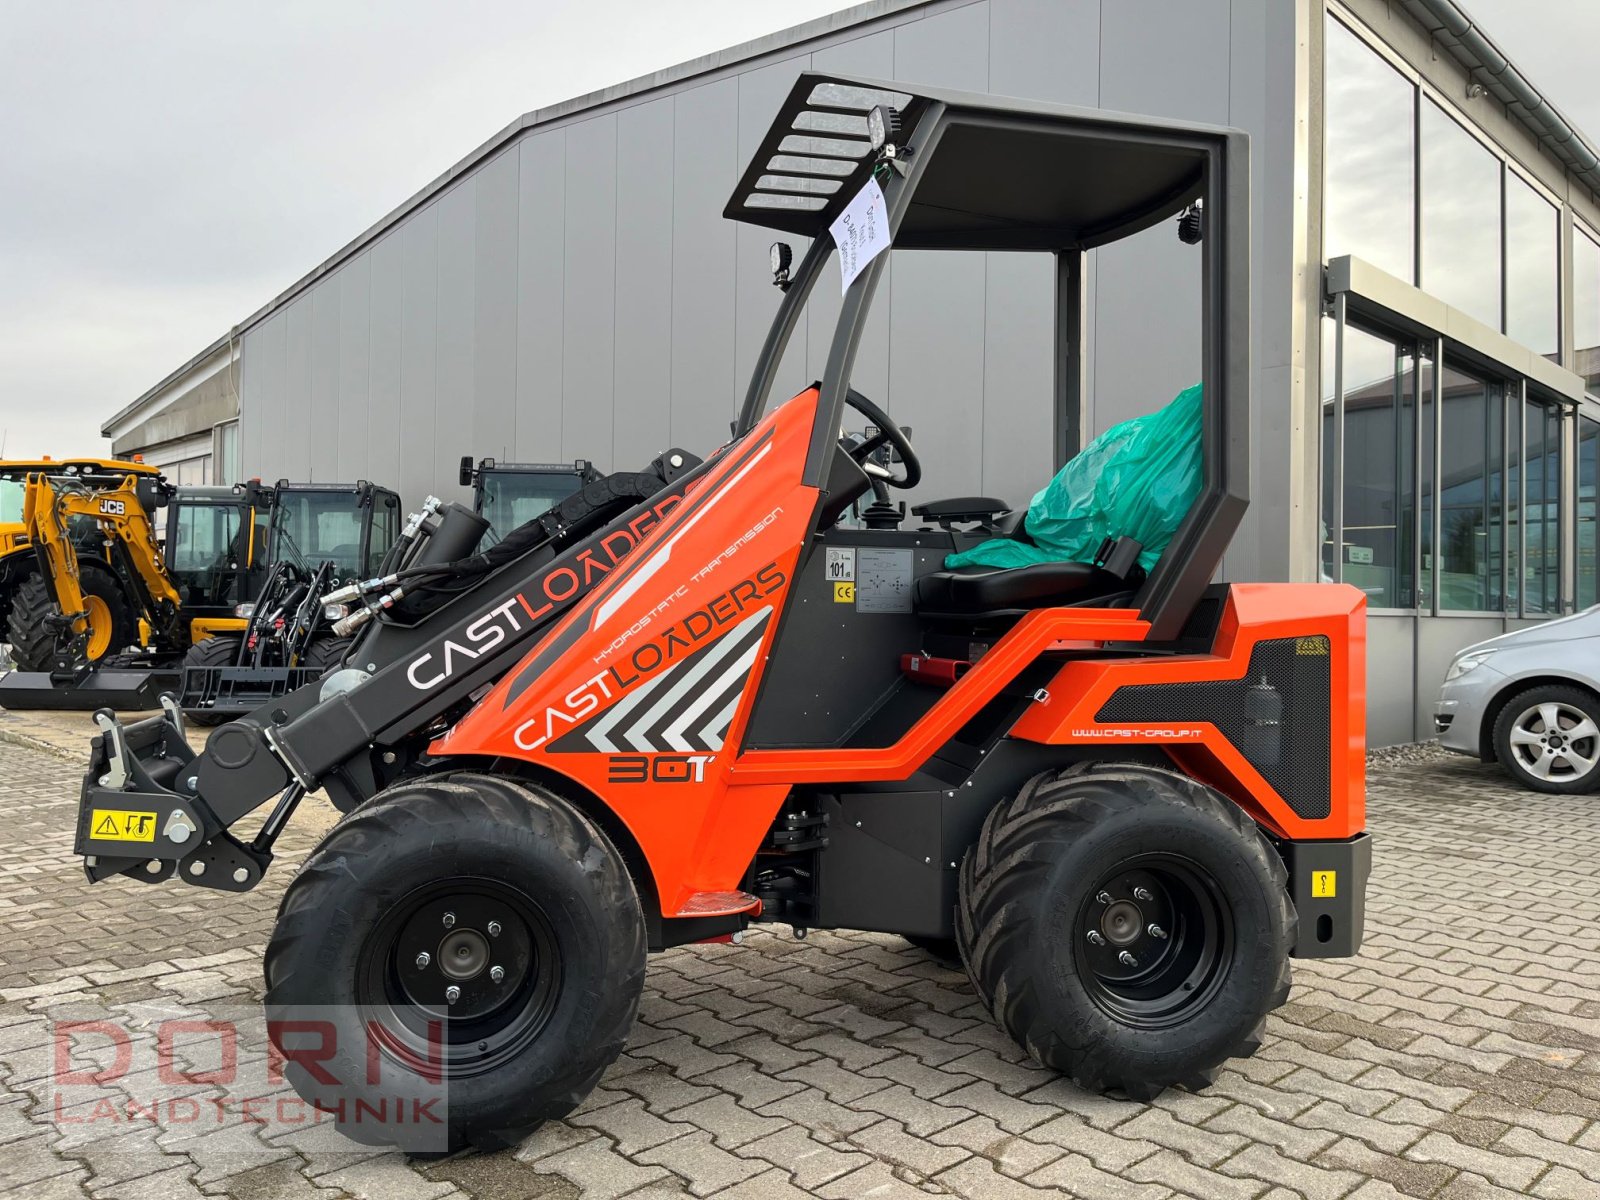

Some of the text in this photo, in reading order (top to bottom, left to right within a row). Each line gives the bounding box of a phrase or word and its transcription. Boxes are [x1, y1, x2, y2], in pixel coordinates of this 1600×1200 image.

[100, 499, 125, 515] JCB
[406, 474, 706, 690] CASTLOADER
[592, 506, 784, 665] HYDROSTATIC TRANSMISSION
[830, 562, 844, 577] 101
[837, 587, 851, 598] CE
[513, 561, 787, 751] CASTLOADERS
